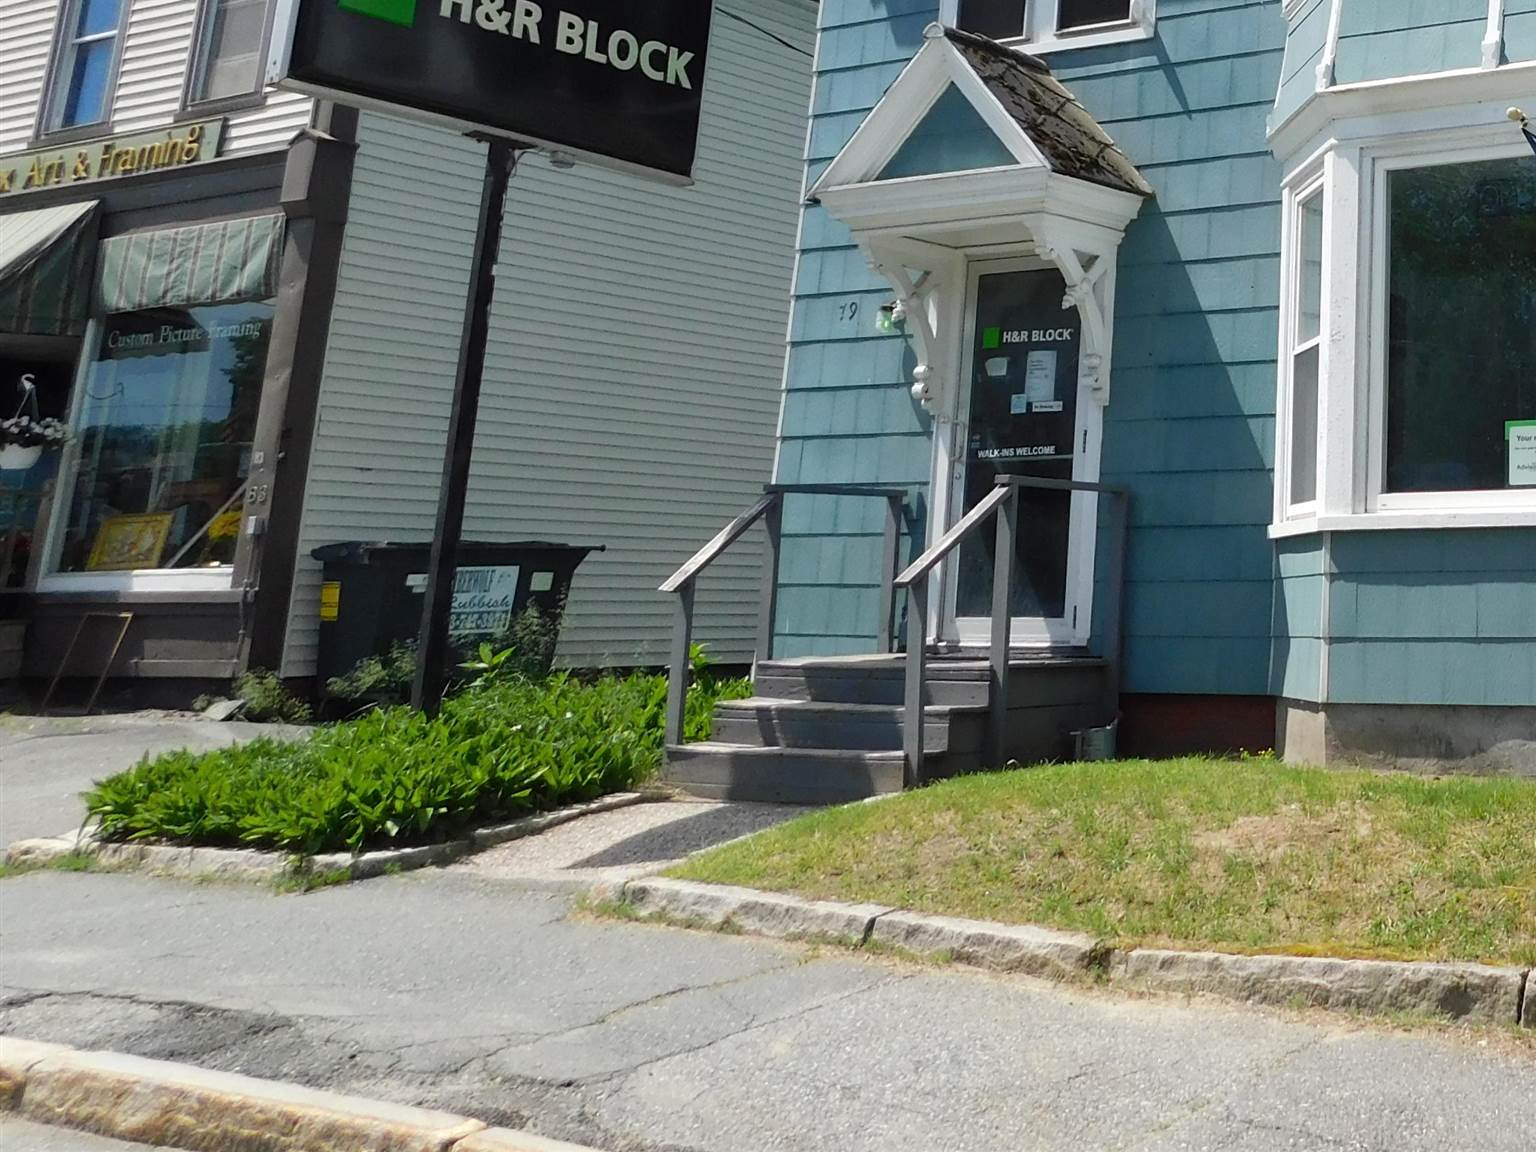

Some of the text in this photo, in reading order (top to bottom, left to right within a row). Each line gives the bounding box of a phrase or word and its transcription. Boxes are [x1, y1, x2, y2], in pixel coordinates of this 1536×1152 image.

[555, 10, 696, 89] BLOCK
[72, 149, 90, 181] &
[98, 125, 202, 176] Framing
[108, 319, 262, 348] Custom Picture Framing
[1002, 328, 1071, 344] H&R BLOCK
[1516, 434, 1532, 442] Your
[977, 445, 1056, 458] WALK-INS WELCOME
